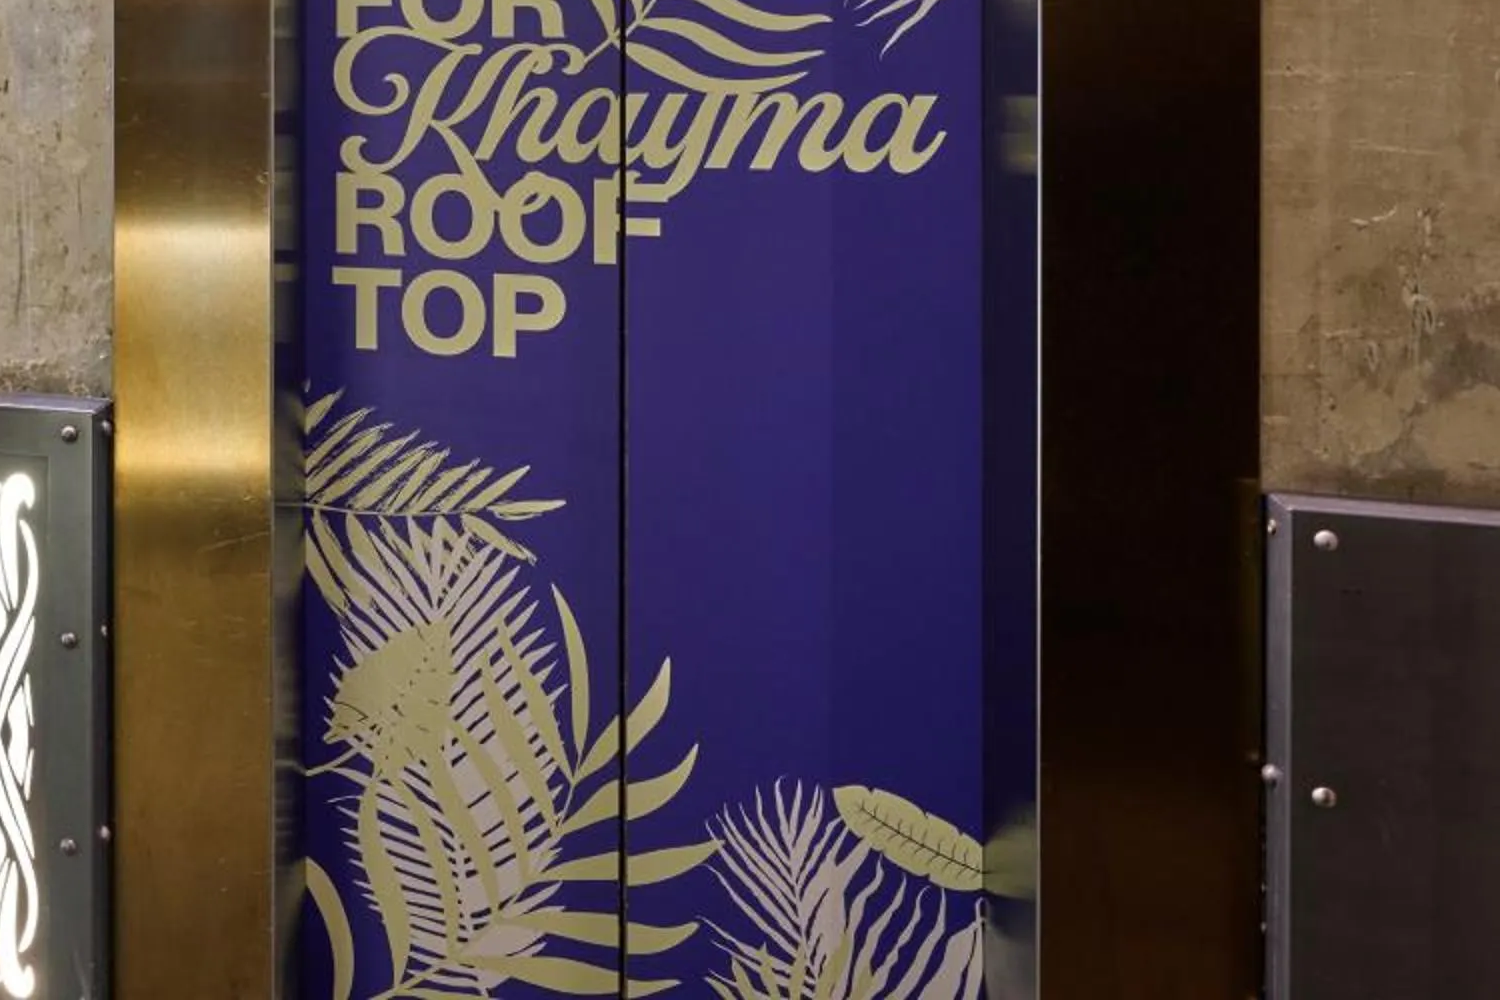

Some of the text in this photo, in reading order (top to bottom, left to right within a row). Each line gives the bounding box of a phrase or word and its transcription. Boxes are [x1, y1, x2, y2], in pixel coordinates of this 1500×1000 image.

[333, 25, 946, 217] Khayma
[335, 171, 670, 264] ROOF
[332, 267, 567, 357] TOP
